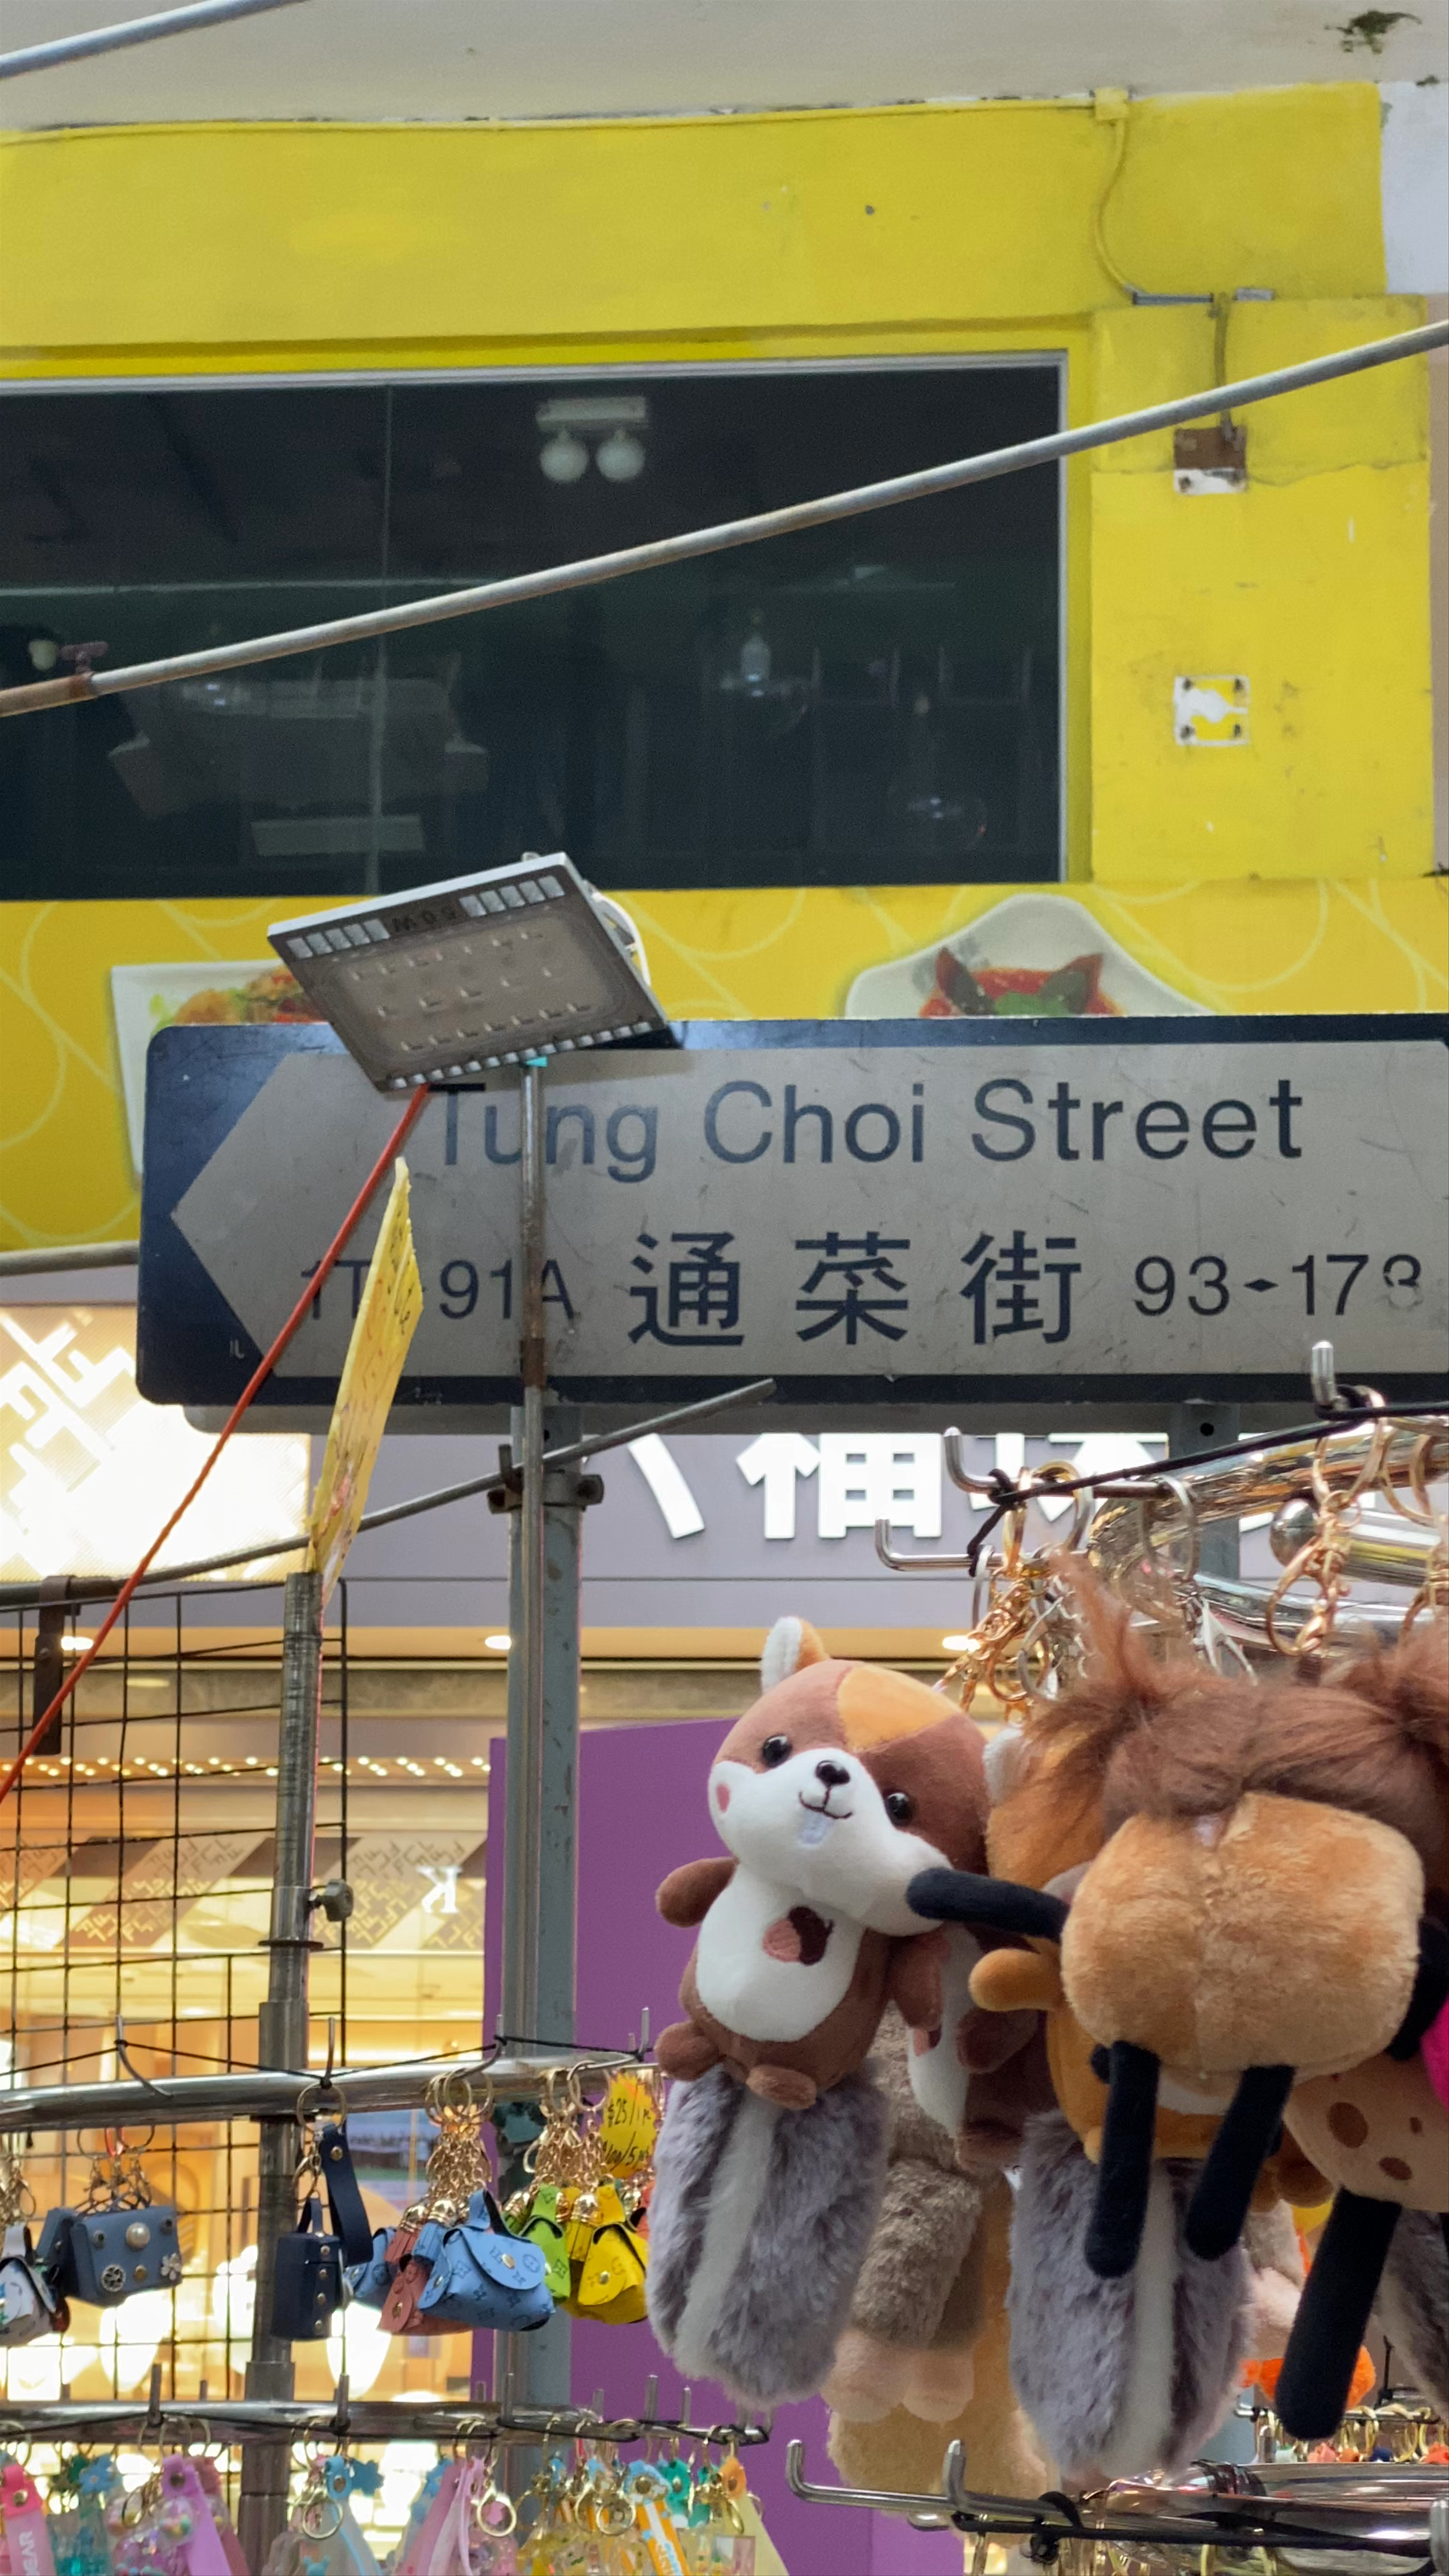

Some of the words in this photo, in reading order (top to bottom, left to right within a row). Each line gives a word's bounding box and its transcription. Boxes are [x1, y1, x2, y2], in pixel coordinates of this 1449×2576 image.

[429, 1082, 657, 1183] Tung
[703, 1081, 924, 1164] Choi
[972, 1079, 1303, 1162] Street
[627, 1230, 1082, 1346] 通菜街
